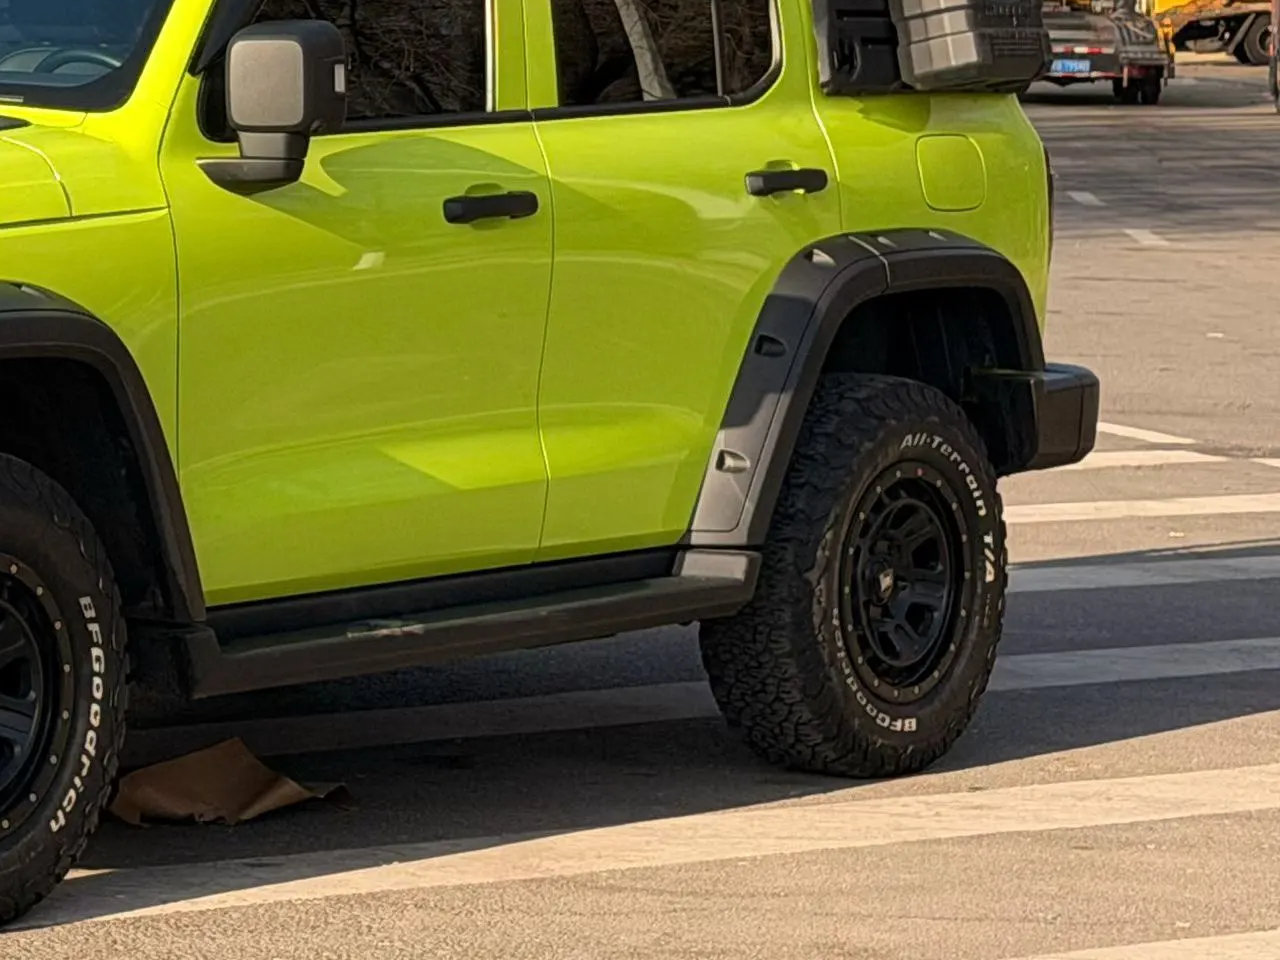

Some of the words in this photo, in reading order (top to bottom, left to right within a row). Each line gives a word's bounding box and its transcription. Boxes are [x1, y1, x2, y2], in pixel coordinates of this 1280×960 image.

[900, 431, 988, 517] All-Terrain
[982, 531, 996, 584] T/A
[49, 595, 105, 833] BFGoodrich
[831, 607, 918, 733] BFGoodrich
